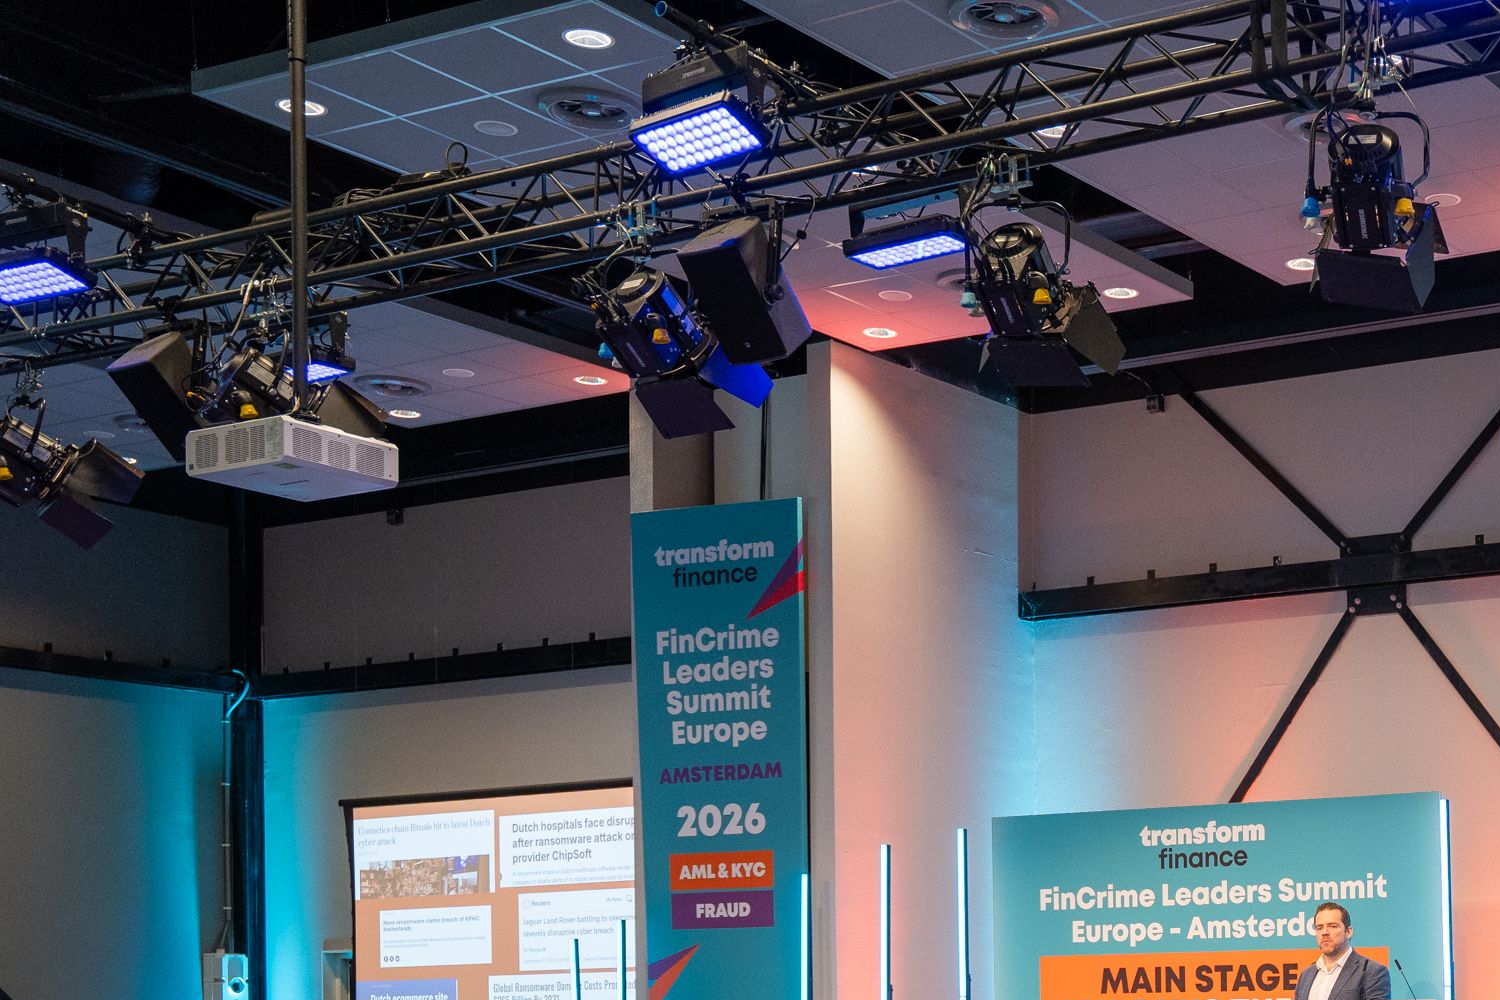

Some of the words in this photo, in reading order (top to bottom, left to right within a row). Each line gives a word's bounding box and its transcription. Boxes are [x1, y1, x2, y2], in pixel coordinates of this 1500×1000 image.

[654, 539, 774, 567] transform
[673, 566, 758, 588] finance
[656, 624, 779, 655] FinCrime
[663, 655, 774, 685] Leaders
[667, 683, 771, 715] Summit
[672, 720, 768, 748] Europe
[660, 761, 782, 784] AMSTERDAM
[512, 822, 539, 833] Dutch
[541, 819, 583, 833] hospitals
[584, 817, 605, 828] face
[677, 803, 766, 837] 2026
[1139, 820, 1265, 847] transform
[512, 837, 534, 848] after
[535, 835, 592, 847] ransomware
[594, 831, 623, 843] attack
[512, 852, 550, 866] provider
[552, 848, 592, 862] ChipSoft
[1158, 847, 1248, 869] finance
[679, 864, 716, 880] AML
[718, 863, 729, 879] &
[731, 862, 766, 878] KYC
[1040, 883, 1156, 911] FinCrime
[1162, 880, 1272, 907] Leaders
[1278, 872, 1387, 902] Summit
[696, 902, 751, 918] FRAUD
[1072, 920, 1164, 947] Europe
[1186, 911, 1316, 940] Amsterd
[1101, 966, 1186, 994] MAIN
[1195, 963, 1298, 993] STAGE
